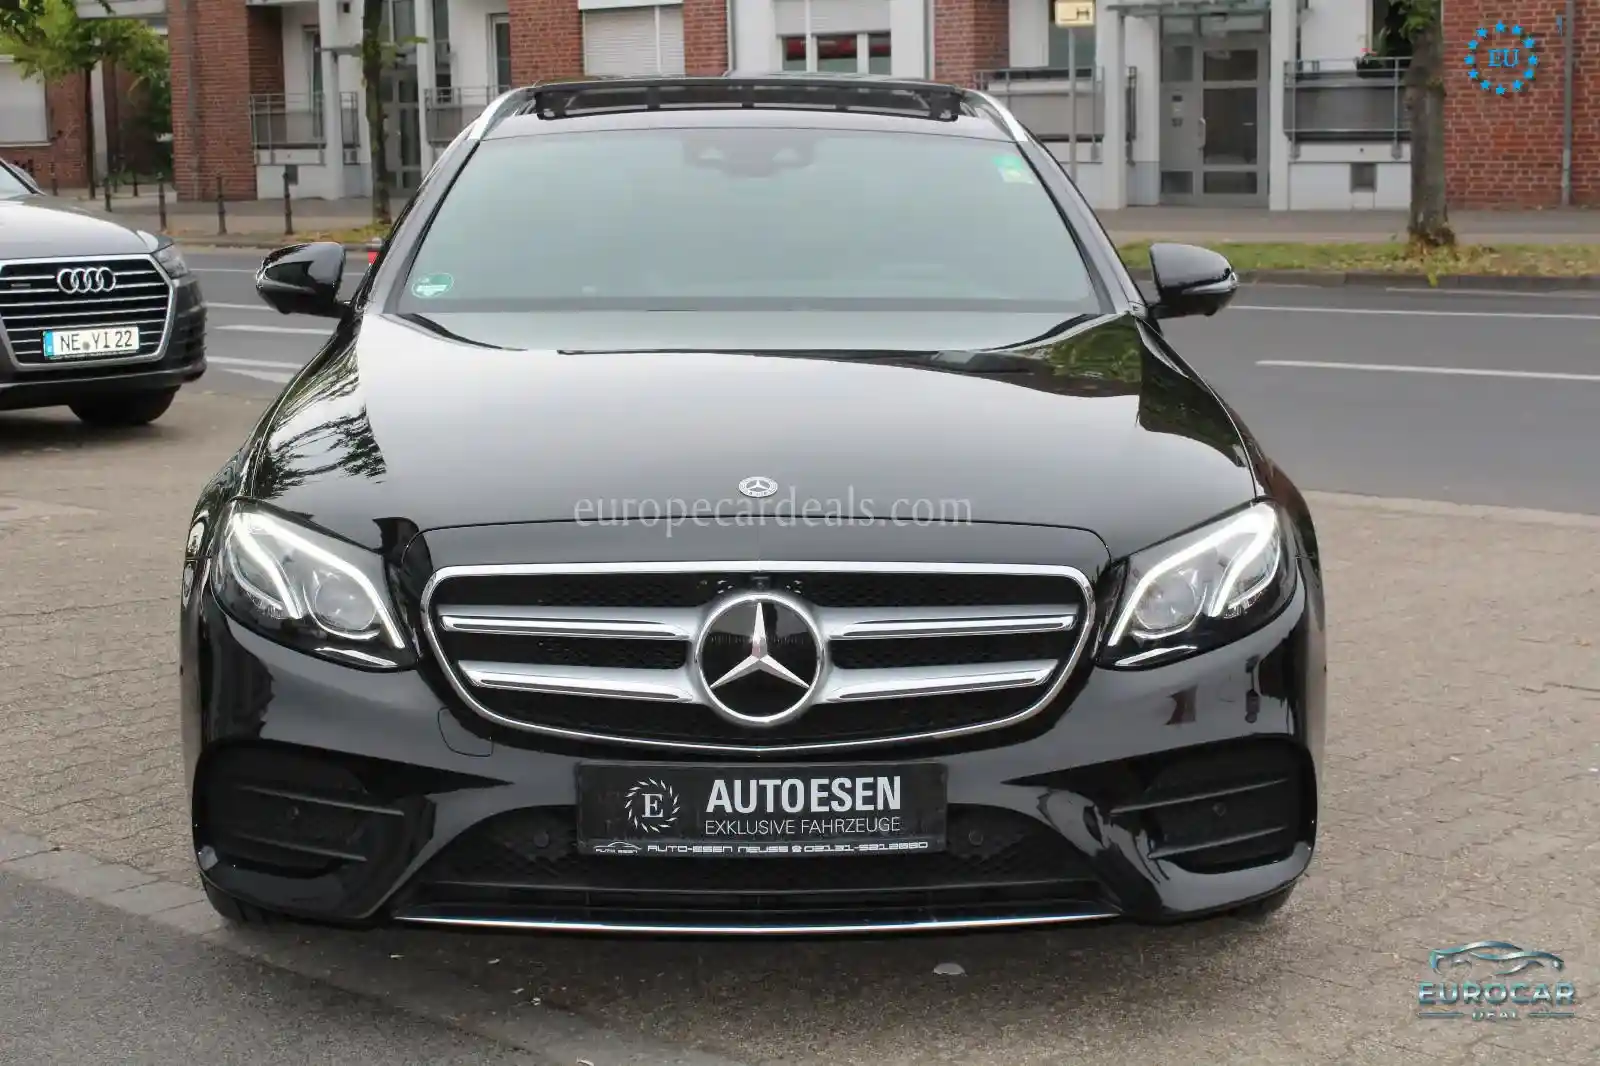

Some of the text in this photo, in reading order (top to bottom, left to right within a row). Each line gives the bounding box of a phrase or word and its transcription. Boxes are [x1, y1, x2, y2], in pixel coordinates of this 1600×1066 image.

[60, 334, 81, 352] NE
[115, 330, 133, 348] 22
[641, 793, 664, 818] E
[705, 816, 901, 835] EXKLUSIVE FAHRZEUGE
